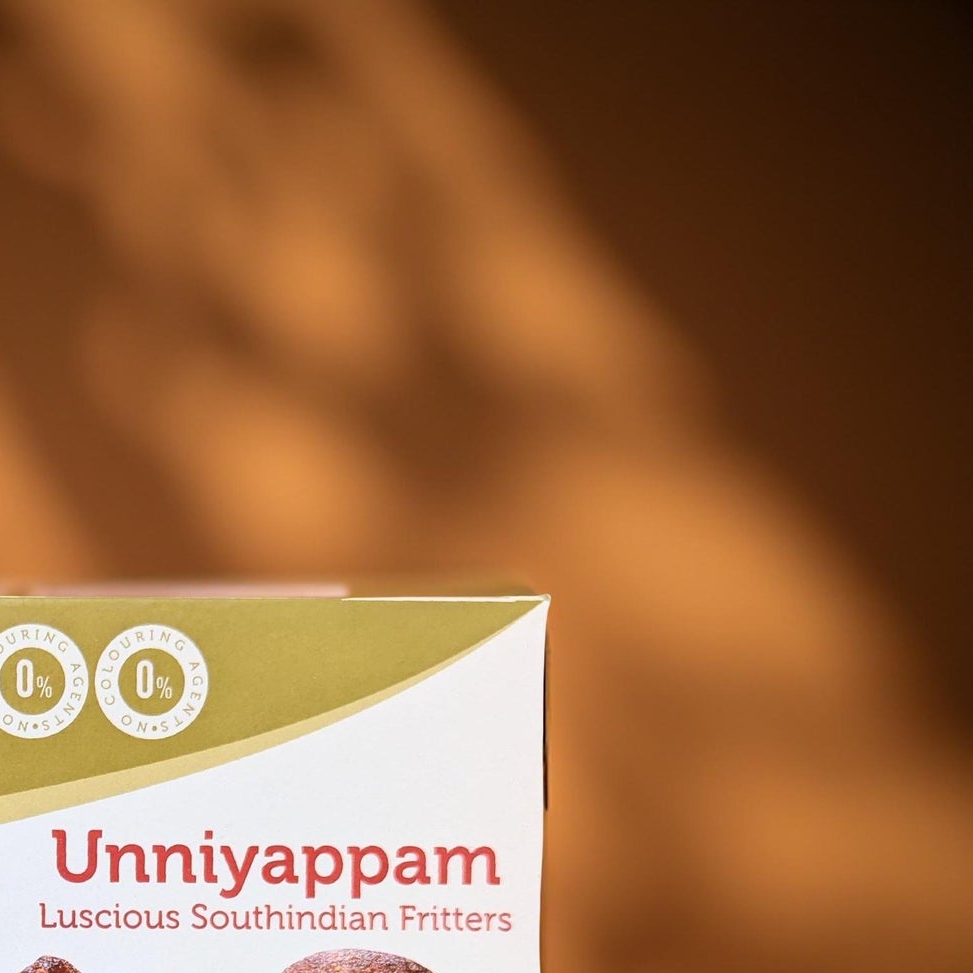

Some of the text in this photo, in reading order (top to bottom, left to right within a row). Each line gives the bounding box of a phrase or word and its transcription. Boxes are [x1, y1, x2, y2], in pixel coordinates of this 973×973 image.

[3, 714, 29, 732] NO
[41, 663, 84, 731] AGENTS
[16, 659, 52, 698] 0%
[101, 630, 203, 733] NO COLOURING AGENTS
[136, 660, 172, 699] 0%
[51, 829, 501, 899] Unniyappam
[39, 902, 513, 933] Luscious Southindian Fritters
